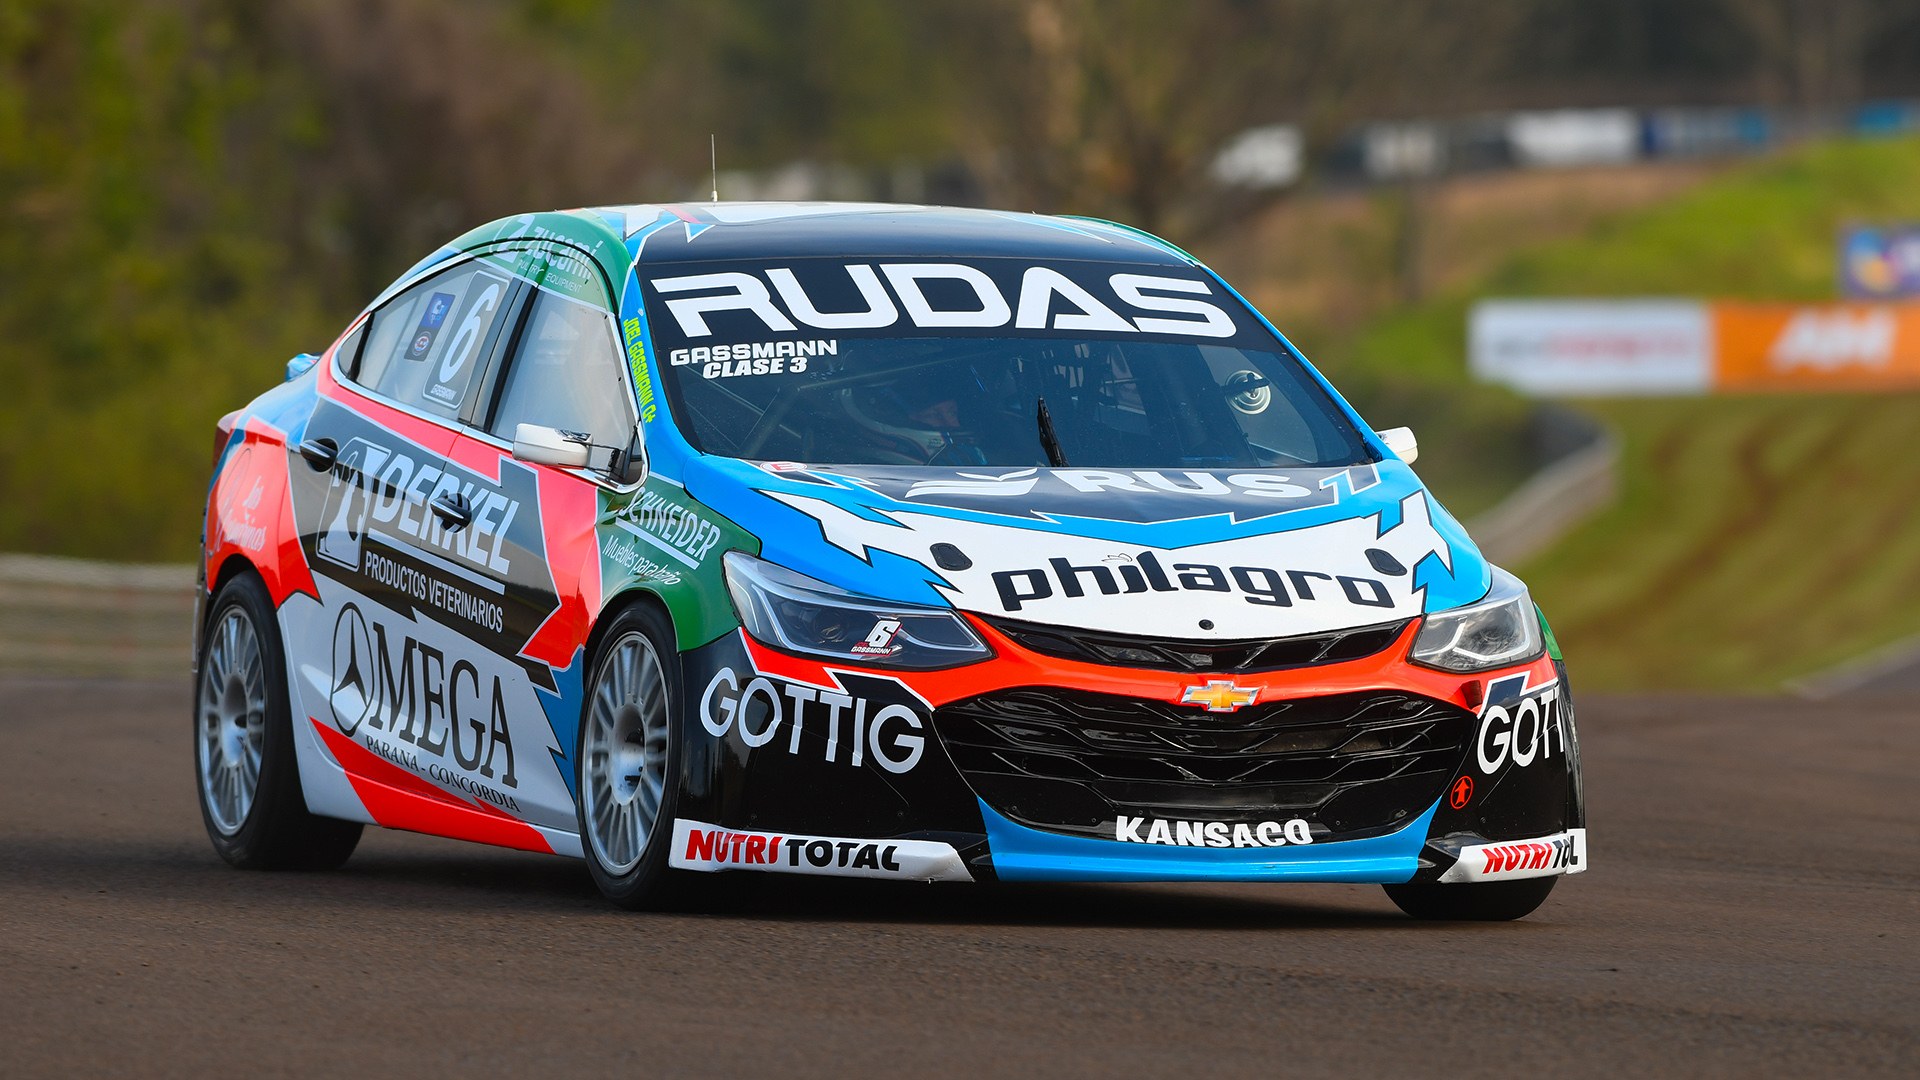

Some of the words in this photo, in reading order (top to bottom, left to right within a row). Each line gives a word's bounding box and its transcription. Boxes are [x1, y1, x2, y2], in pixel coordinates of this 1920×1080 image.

[545, 272, 582, 293] EQUIPMENT
[650, 263, 1237, 338] RUDAS
[440, 283, 500, 383] 6
[623, 317, 642, 347] JOEL
[670, 339, 838, 366] GASSMANN
[629, 340, 655, 409] GASSMANN
[702, 357, 785, 379] CLASE
[789, 357, 808, 373] 3
[1049, 470, 1312, 498] RUS
[618, 486, 721, 562] SCHNEIDER
[602, 534, 639, 568] Muebles
[628, 556, 659, 576] para
[364, 550, 427, 601] PRODUCTOS
[428, 577, 503, 633] VETERINARIOS
[991, 550, 1396, 612] philagro
[851, 645, 892, 656] GASSMANN
[863, 619, 902, 649] 6
[700, 666, 925, 774] GOTTIG
[366, 733, 420, 773] PARANA
[429, 762, 522, 813] CONCORDIA
[1115, 815, 1314, 849] KANSACO
